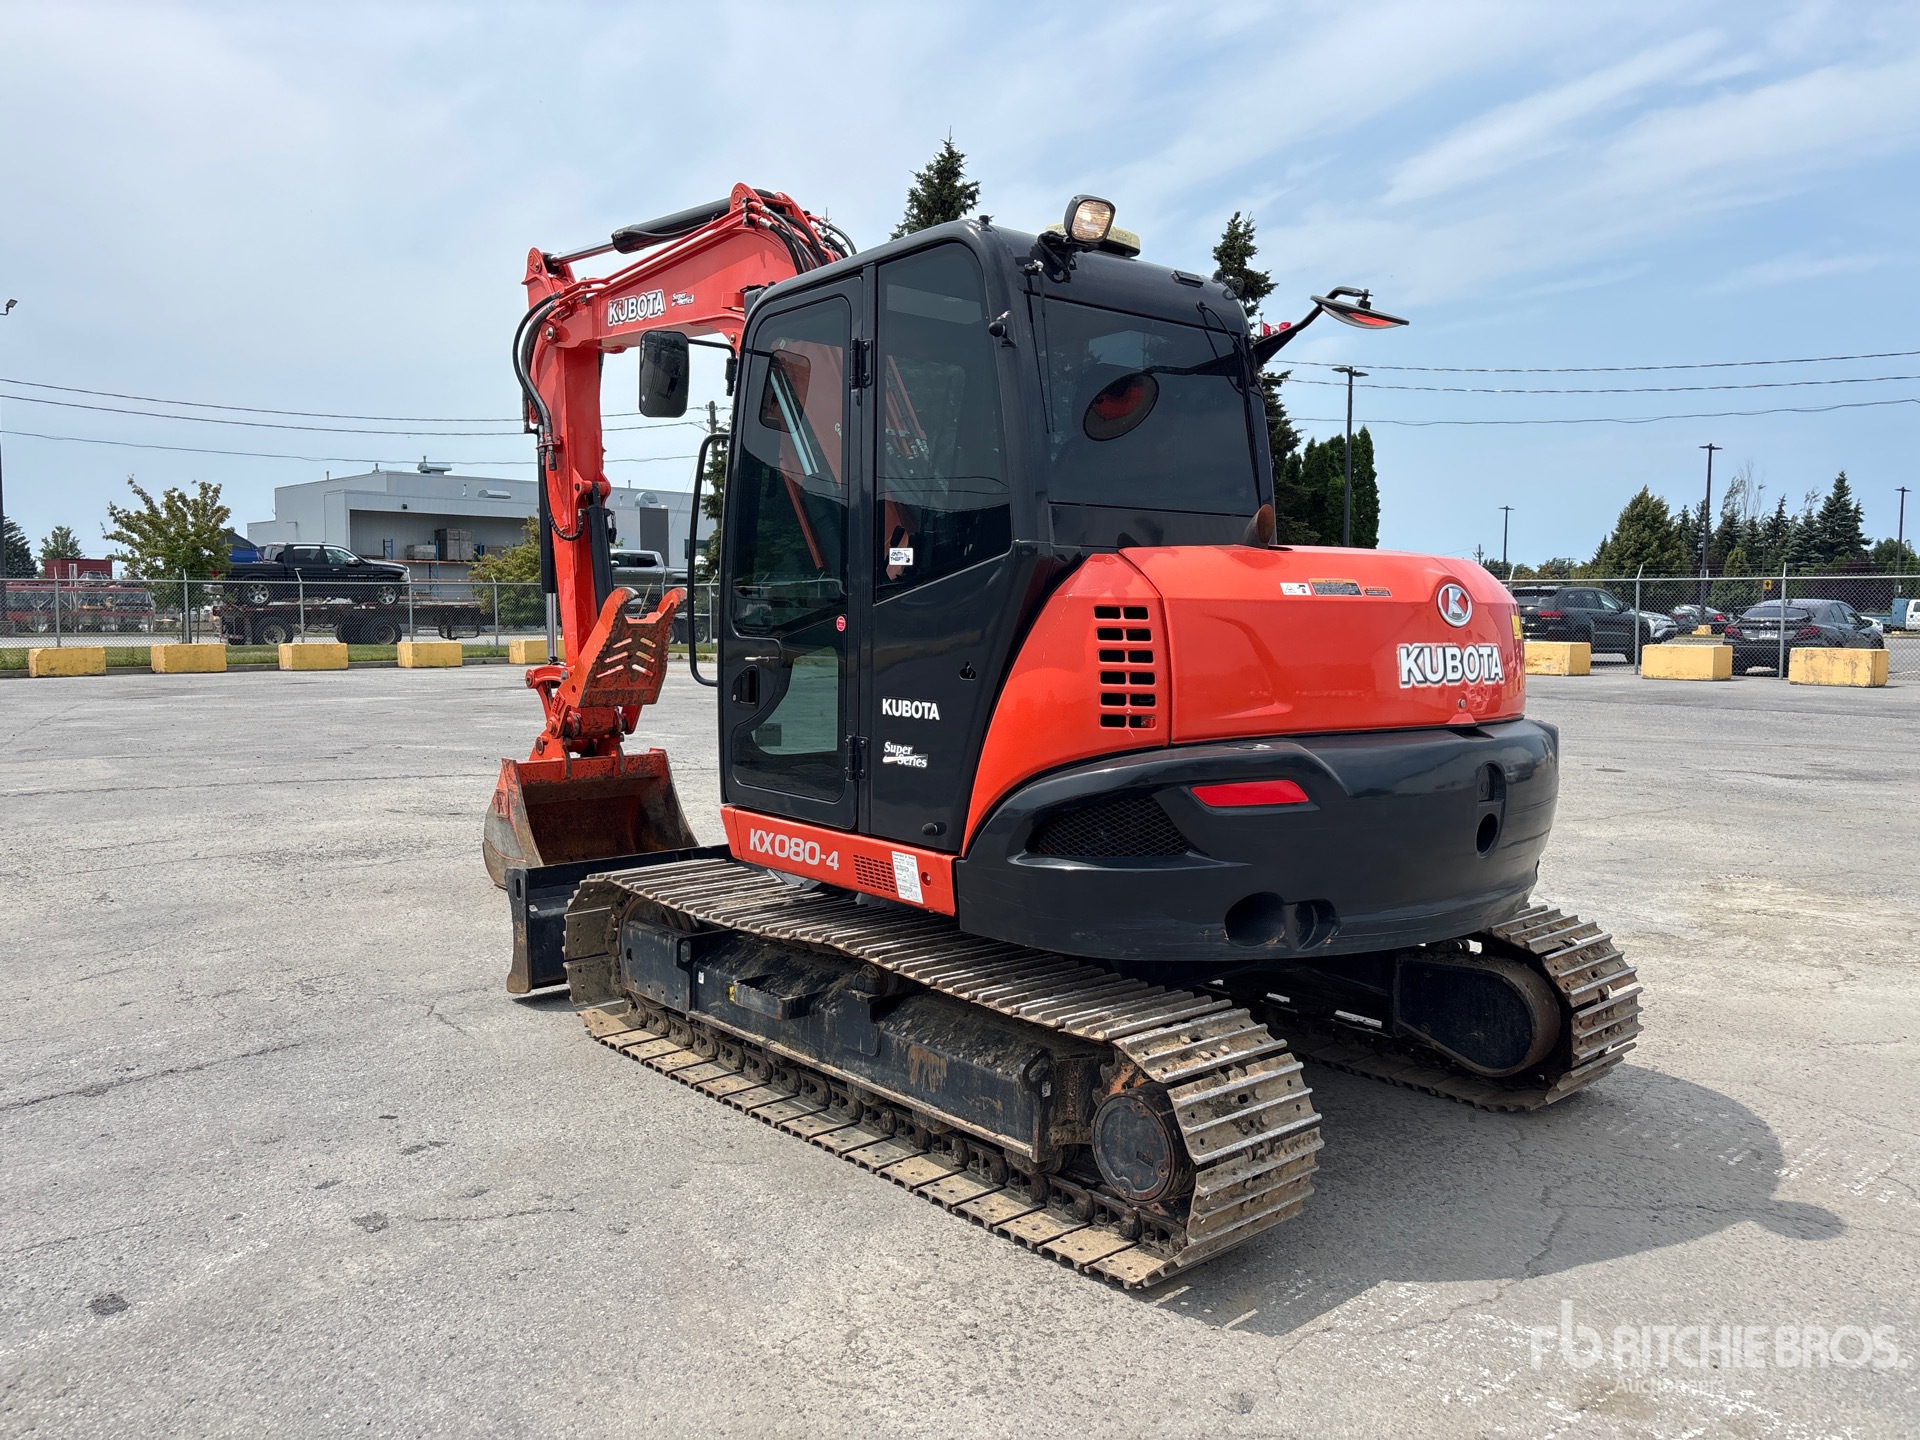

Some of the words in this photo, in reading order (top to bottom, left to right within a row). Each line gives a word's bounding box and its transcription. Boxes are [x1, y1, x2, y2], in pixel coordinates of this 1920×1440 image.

[609, 290, 666, 325] KUBOTA
[1398, 643, 1504, 688] KUBOTA
[882, 697, 940, 721] KUBOTA
[883, 741, 913, 756] Super
[897, 753, 928, 768] Series
[749, 828, 839, 871] KX080-4
